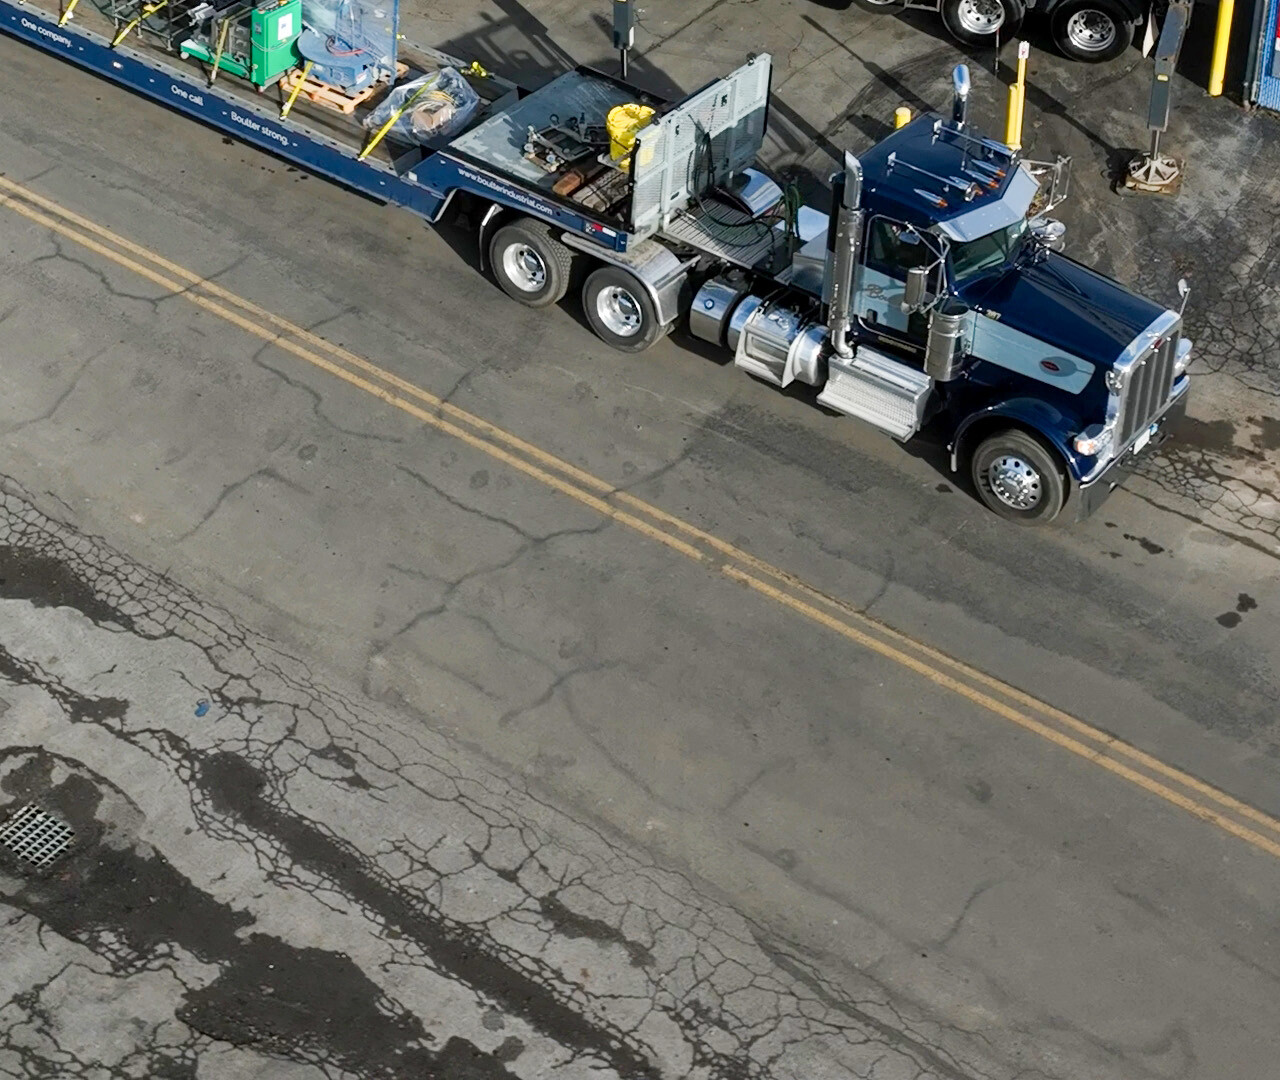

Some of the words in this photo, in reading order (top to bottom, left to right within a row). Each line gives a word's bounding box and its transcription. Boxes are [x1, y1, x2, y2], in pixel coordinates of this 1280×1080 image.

[21, 17, 37, 32] One
[170, 84, 188, 99] One
[230, 110, 261, 131] Boulter
[457, 168, 553, 216] www.boulterindustrial.com
